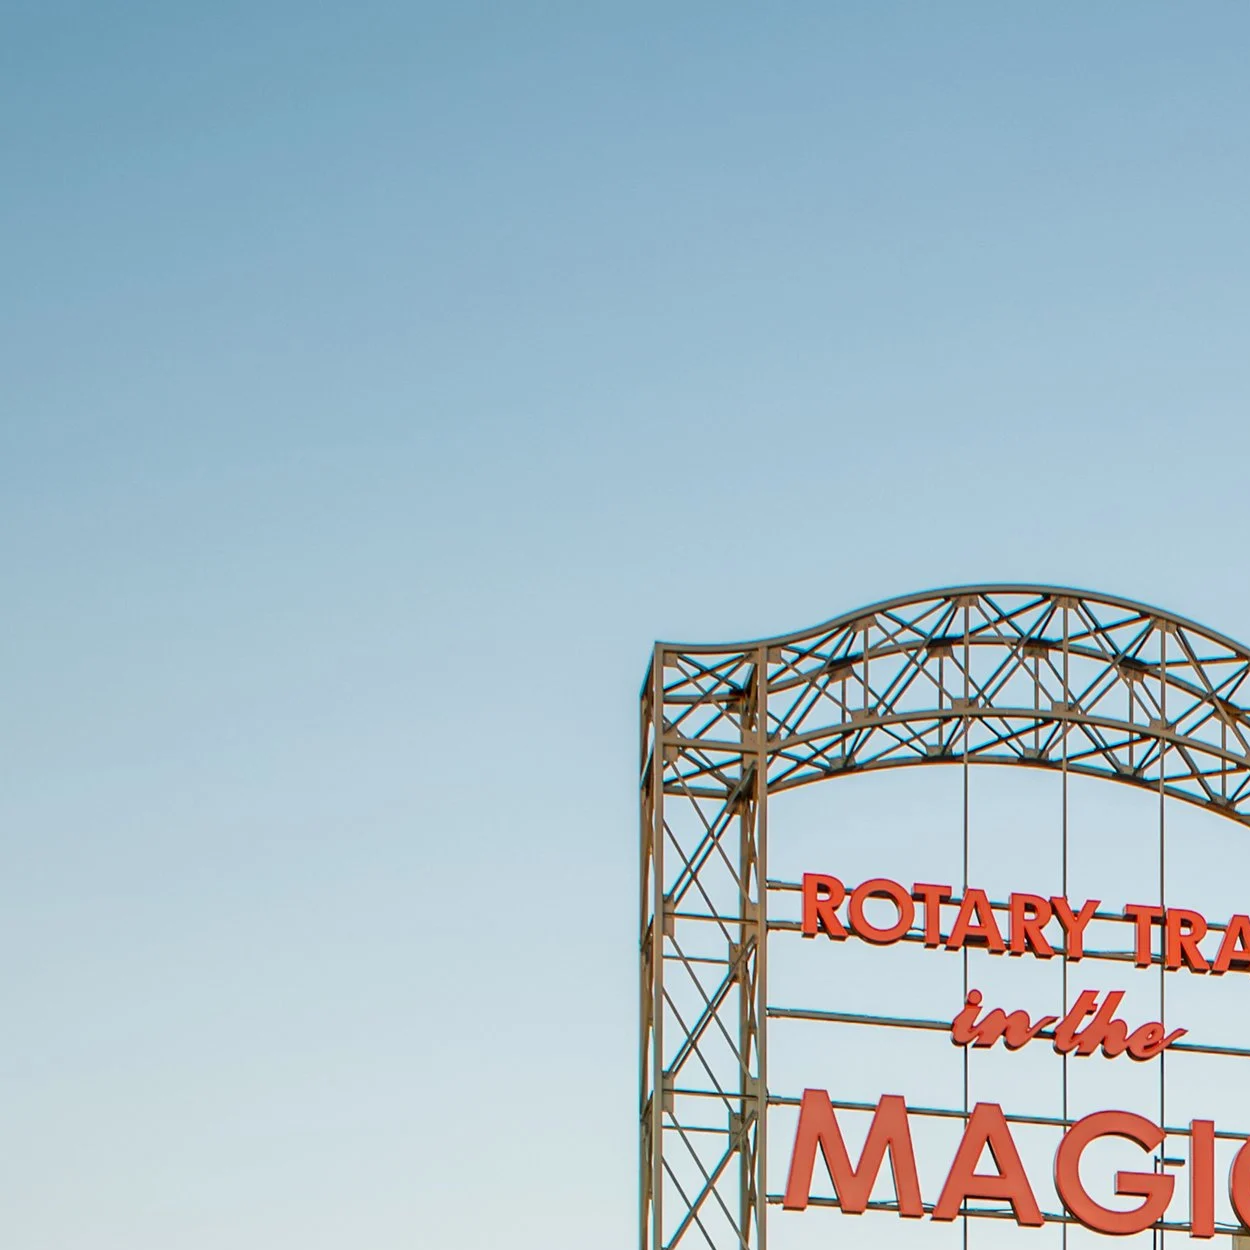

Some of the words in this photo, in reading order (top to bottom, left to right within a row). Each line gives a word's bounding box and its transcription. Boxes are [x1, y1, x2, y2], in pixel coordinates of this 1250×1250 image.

[801, 872, 1101, 961] ROTARY
[951, 988, 1058, 1050] in
[1053, 989, 1188, 1061] the
